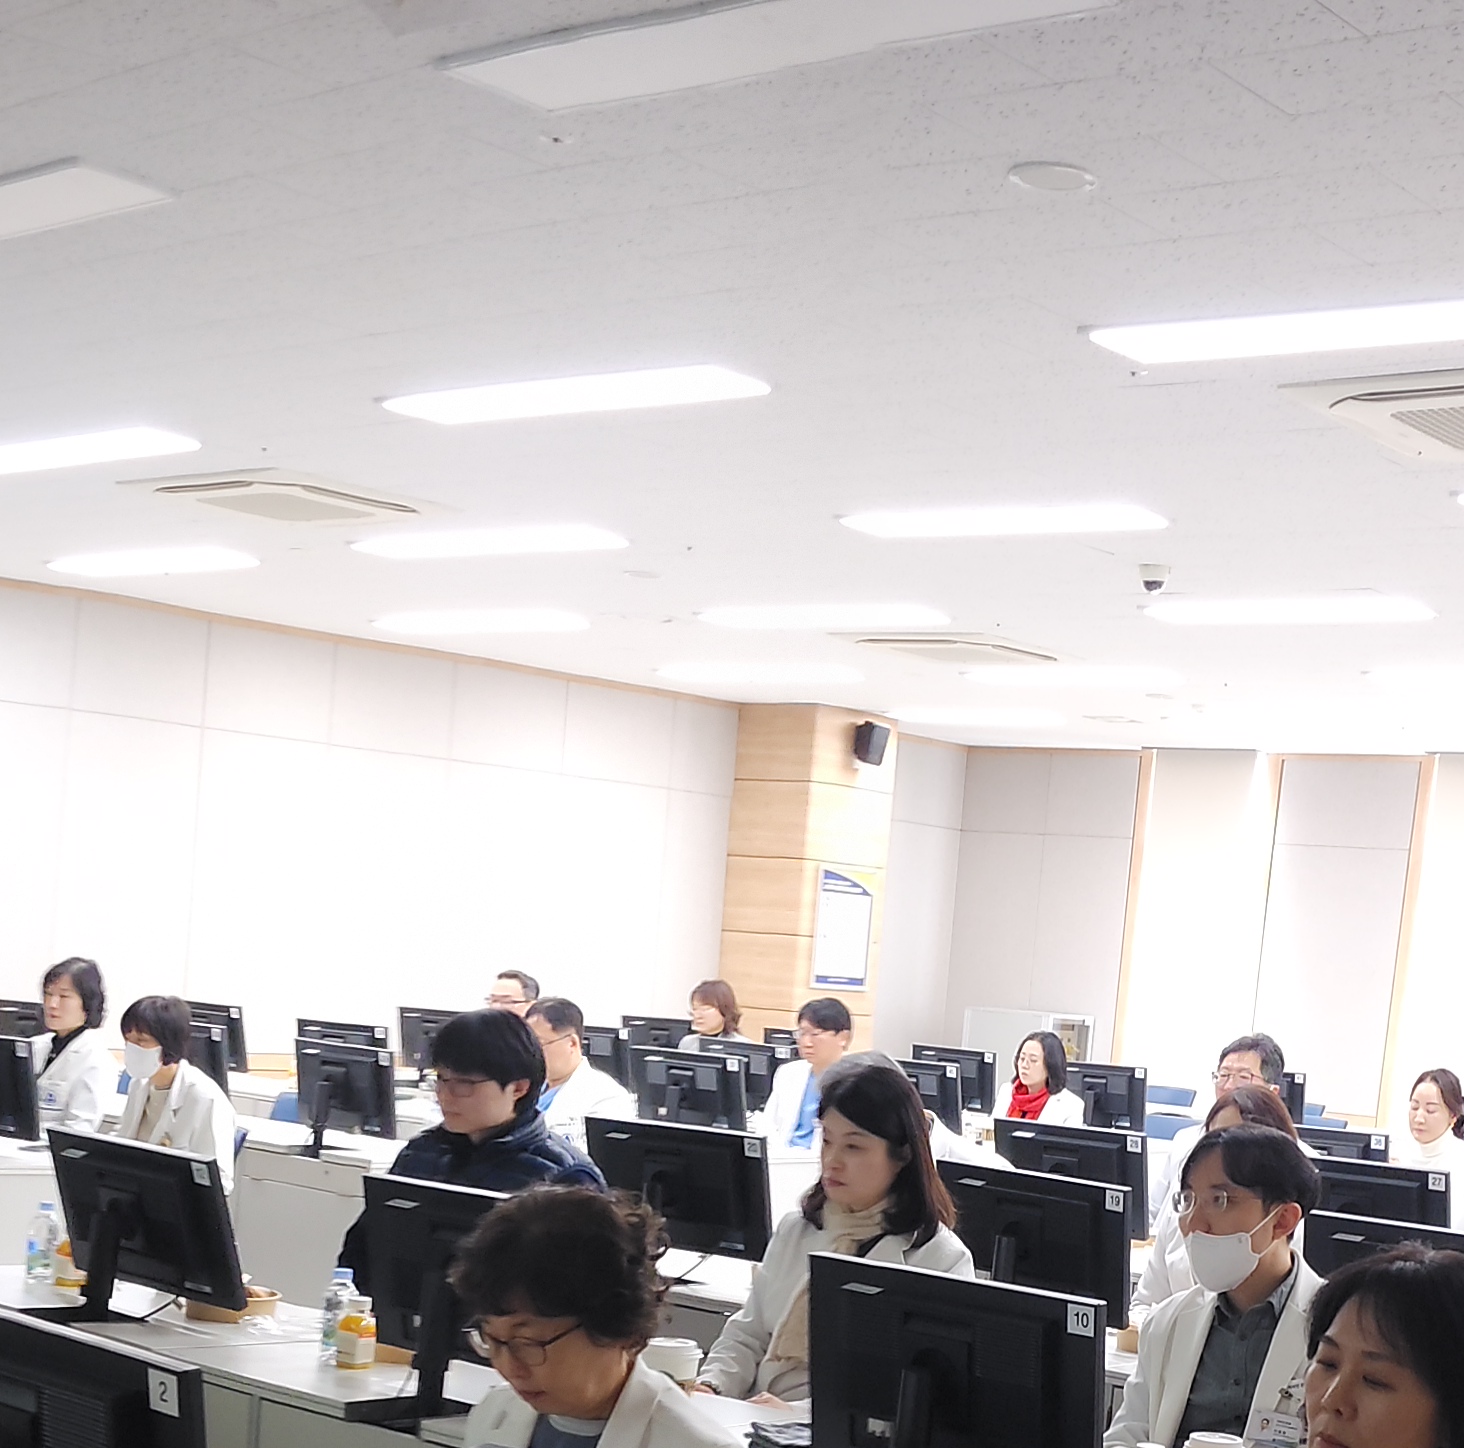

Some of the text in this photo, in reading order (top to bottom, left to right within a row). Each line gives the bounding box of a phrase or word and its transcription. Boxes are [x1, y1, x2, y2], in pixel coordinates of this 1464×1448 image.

[1431, 1177, 1442, 1187] 27
[1109, 1195, 1121, 1207] 19
[1073, 1310, 1089, 1329] 10
[159, 1381, 170, 1404] 2
